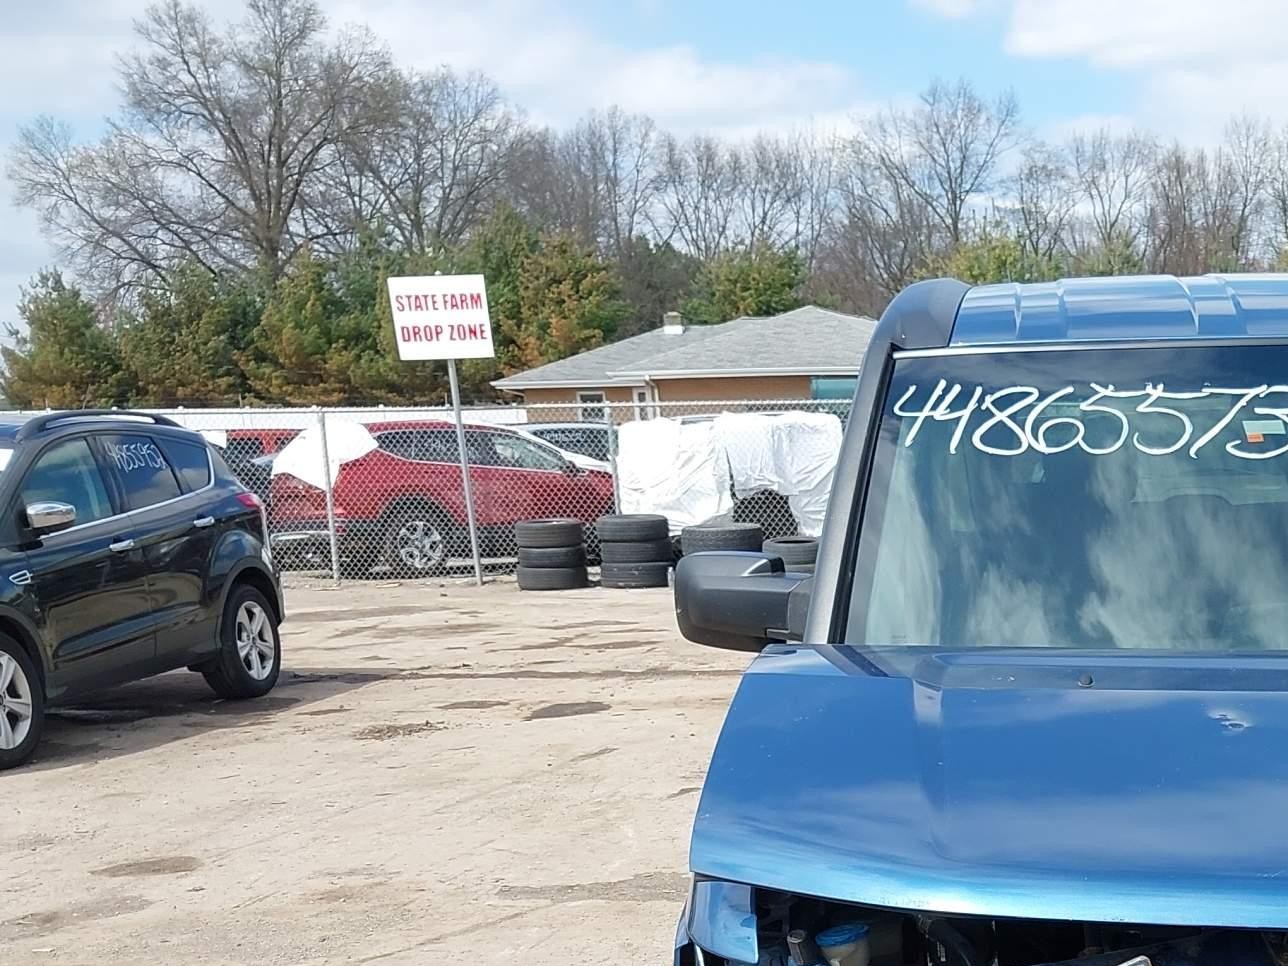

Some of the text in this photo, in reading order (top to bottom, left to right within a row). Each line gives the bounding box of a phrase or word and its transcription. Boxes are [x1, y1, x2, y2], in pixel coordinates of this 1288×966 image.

[395, 292, 482, 312] STATE FARM
[400, 323, 487, 342] DROP ZONE
